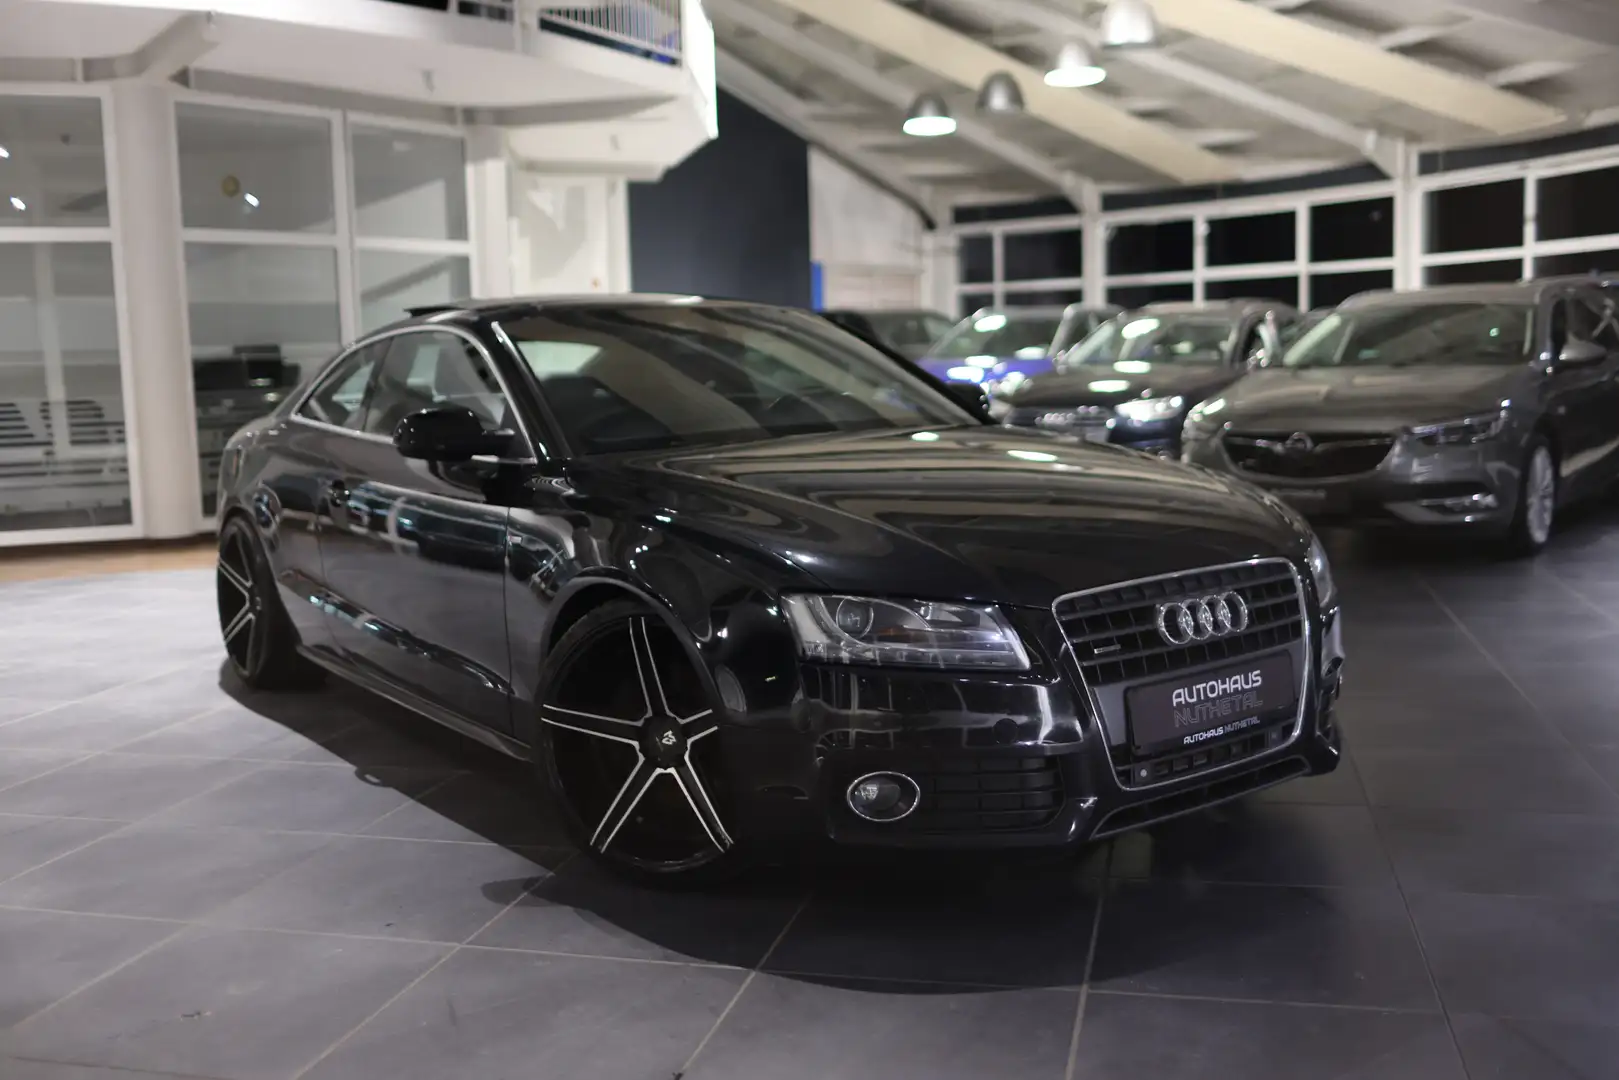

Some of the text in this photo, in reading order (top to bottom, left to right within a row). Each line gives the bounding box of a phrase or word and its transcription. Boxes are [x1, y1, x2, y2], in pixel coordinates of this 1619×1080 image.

[1172, 670, 1262, 706] AUTOHAUS
[1174, 691, 1263, 727] NUTHETAL
[1183, 716, 1260, 744] AUTOHAUS NUTHETAL
